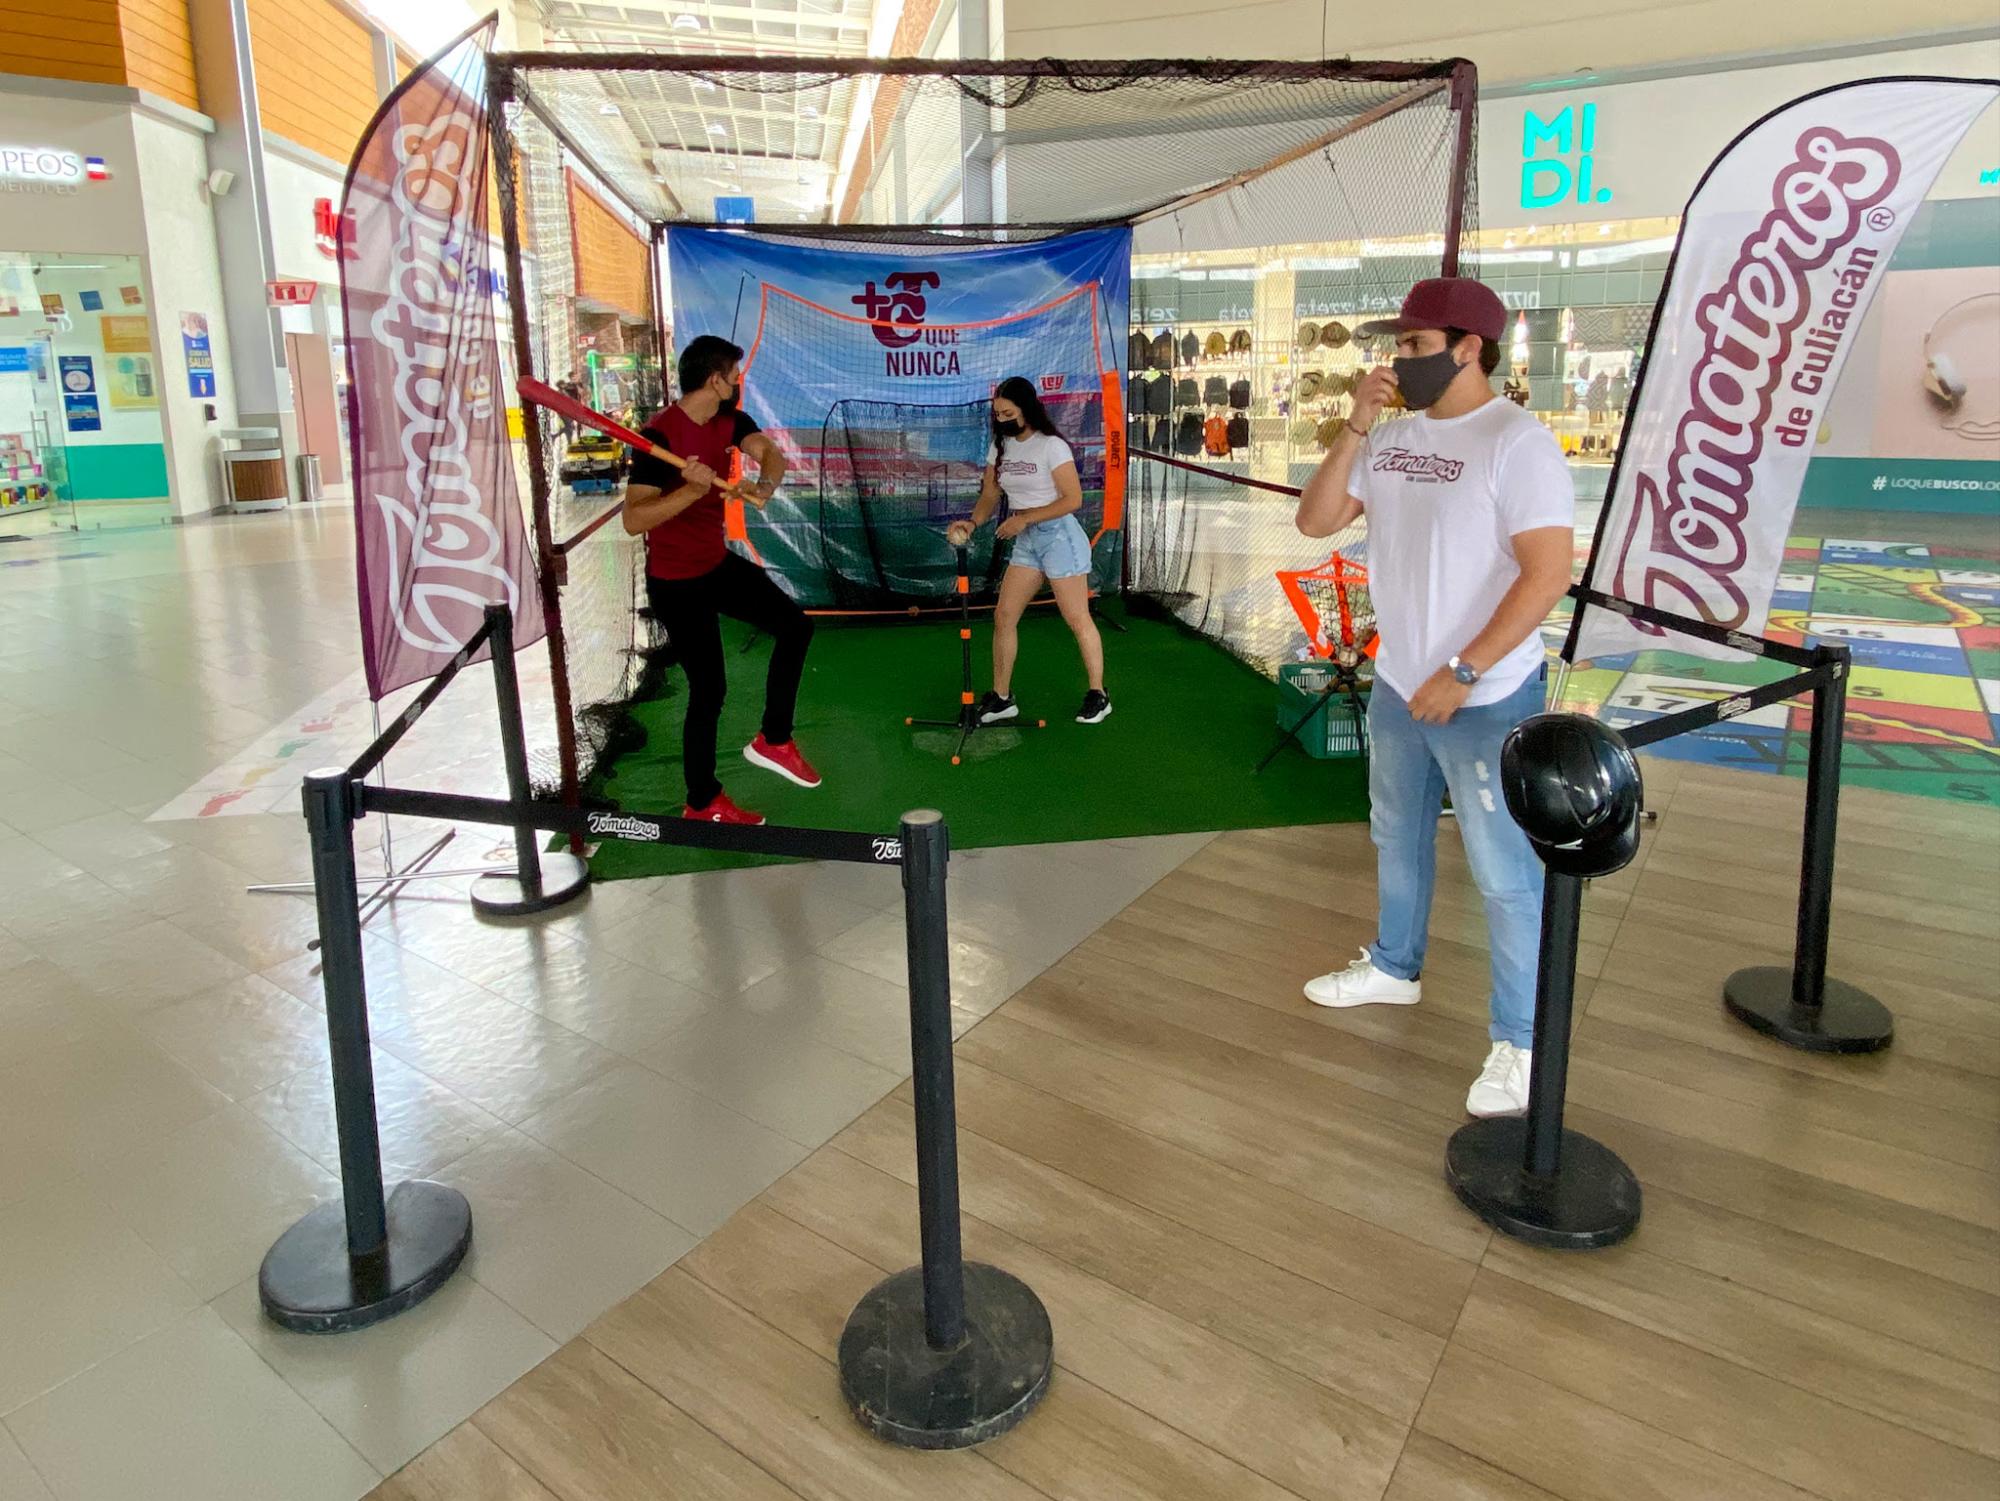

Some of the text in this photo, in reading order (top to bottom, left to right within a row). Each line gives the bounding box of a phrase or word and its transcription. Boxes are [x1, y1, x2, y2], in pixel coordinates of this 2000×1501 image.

[1523, 103, 1597, 158] MI
[1791, 248, 1879, 394] Culiacán
[371, 112, 519, 652] Tomateros
[886, 351, 960, 377] NUNCA
[1612, 126, 1902, 638] Tomateros
[1774, 405, 1814, 447] de
[1620, 695, 1689, 711] 17
[587, 811, 661, 840] Tomateros
